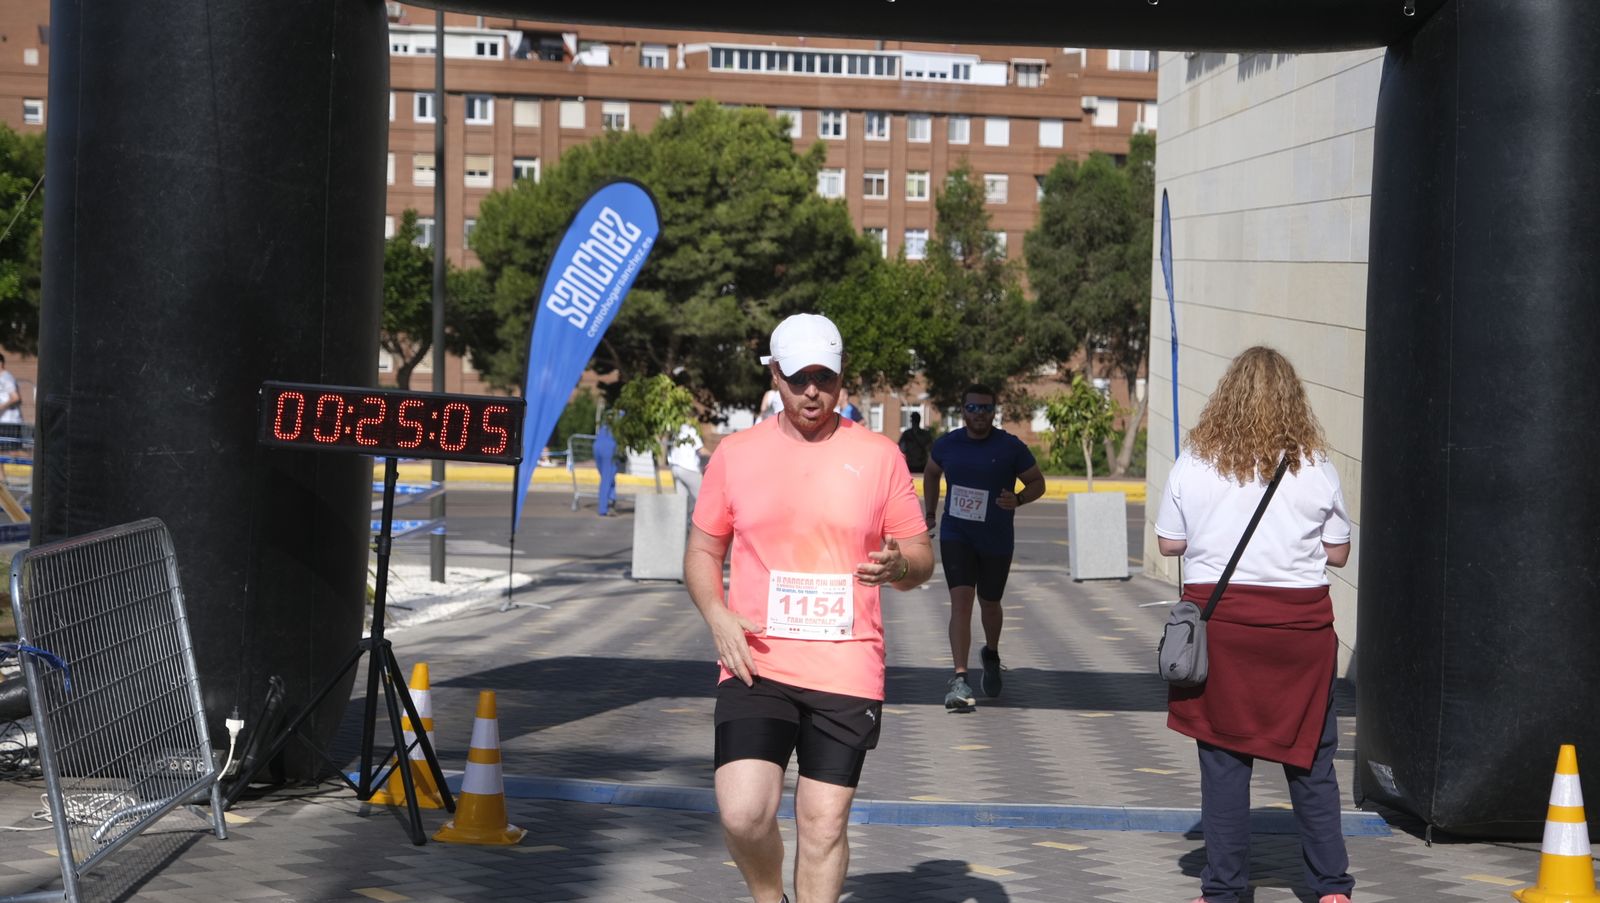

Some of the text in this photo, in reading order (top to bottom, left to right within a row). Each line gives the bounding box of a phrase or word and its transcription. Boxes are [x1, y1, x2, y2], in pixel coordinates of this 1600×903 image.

[587, 236, 653, 338] centrohogarsanchez.es
[274, 391, 508, 454] 00:25:05
[954, 496, 982, 510] 1027
[779, 595, 846, 617] 1154
